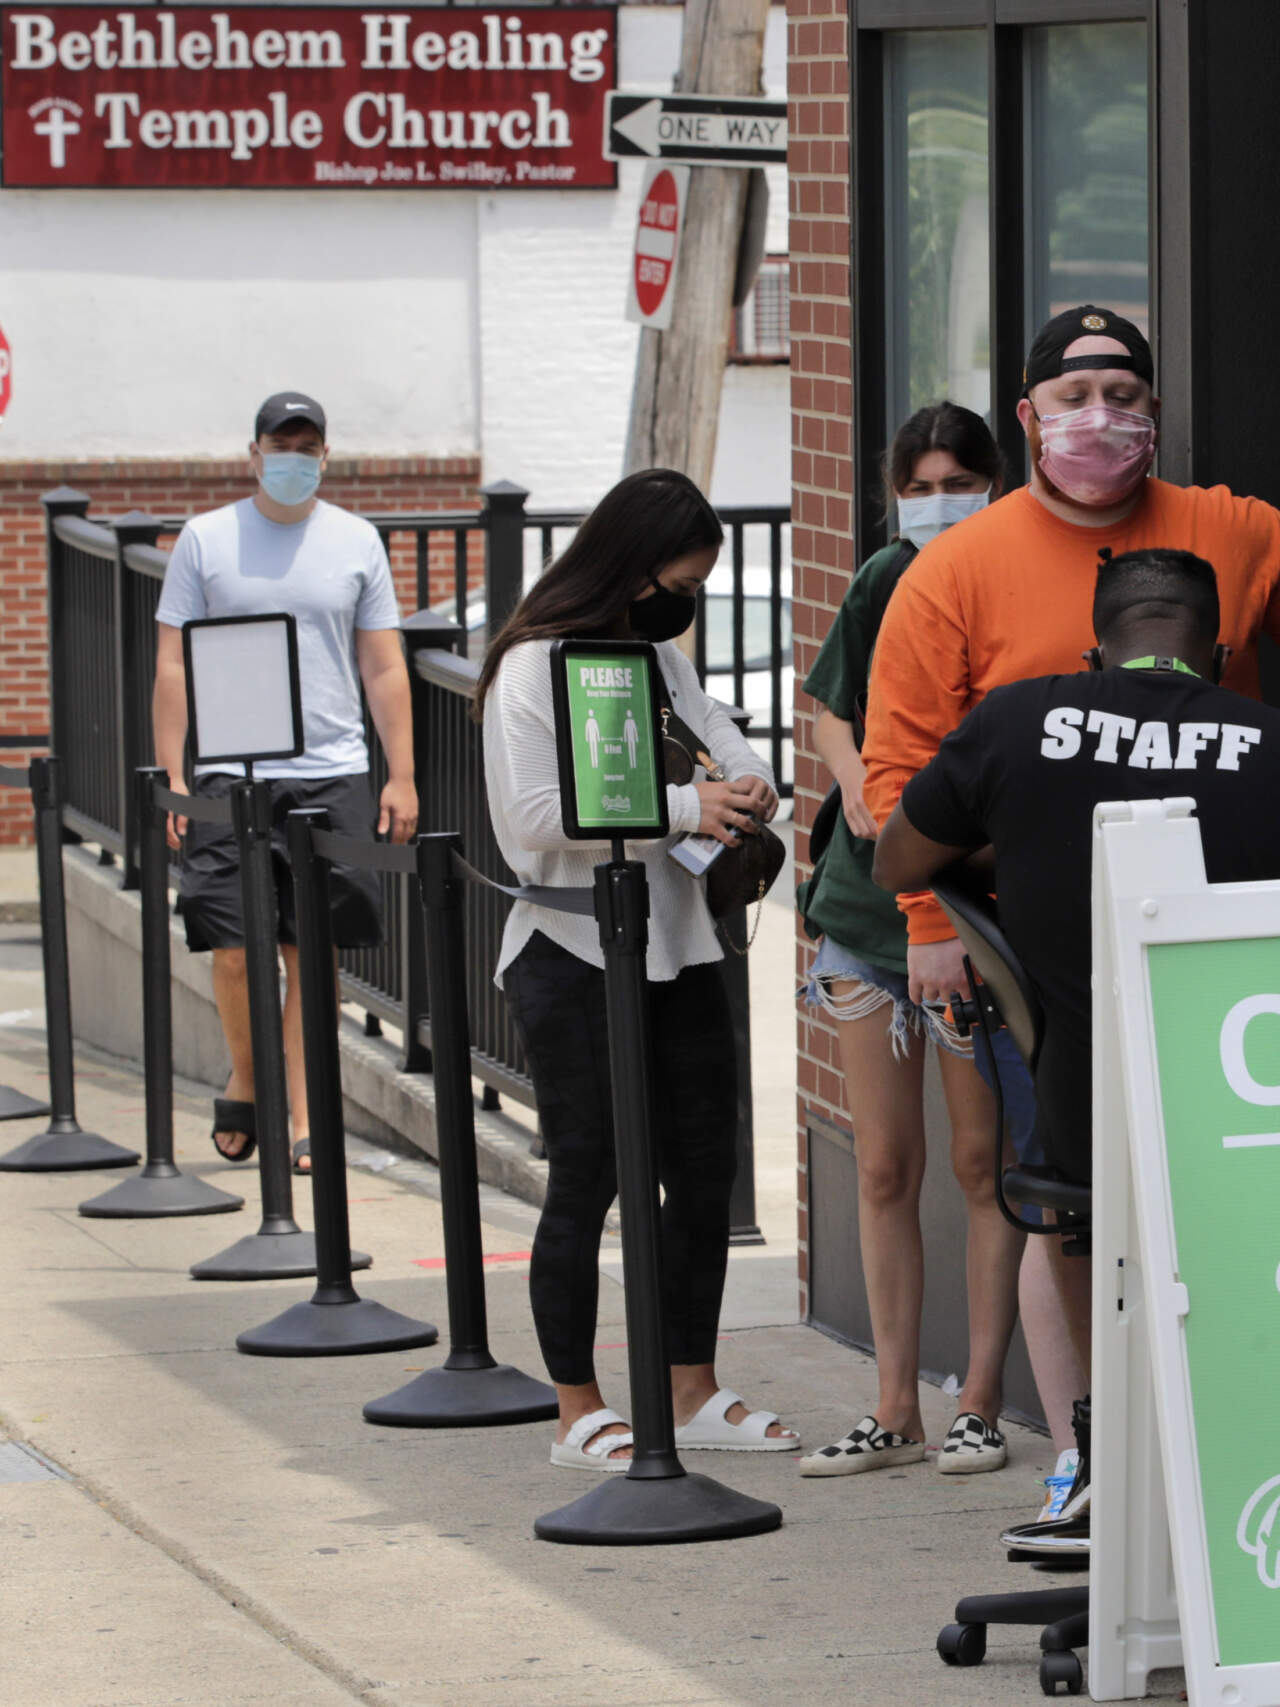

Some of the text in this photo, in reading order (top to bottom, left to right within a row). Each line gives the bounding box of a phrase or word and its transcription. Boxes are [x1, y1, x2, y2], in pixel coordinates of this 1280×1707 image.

[10, 13, 608, 82] Bethlehem Healing
[95, 92, 572, 160] Temple Church
[658, 117, 780, 143] ONE WAY
[315, 161, 378, 183] Bishop
[380, 161, 413, 180] Joe
[416, 161, 435, 181] L.
[516, 161, 576, 181] Pastor
[579, 667, 633, 688] PLEASE
[1041, 707, 1261, 771] STAFF
